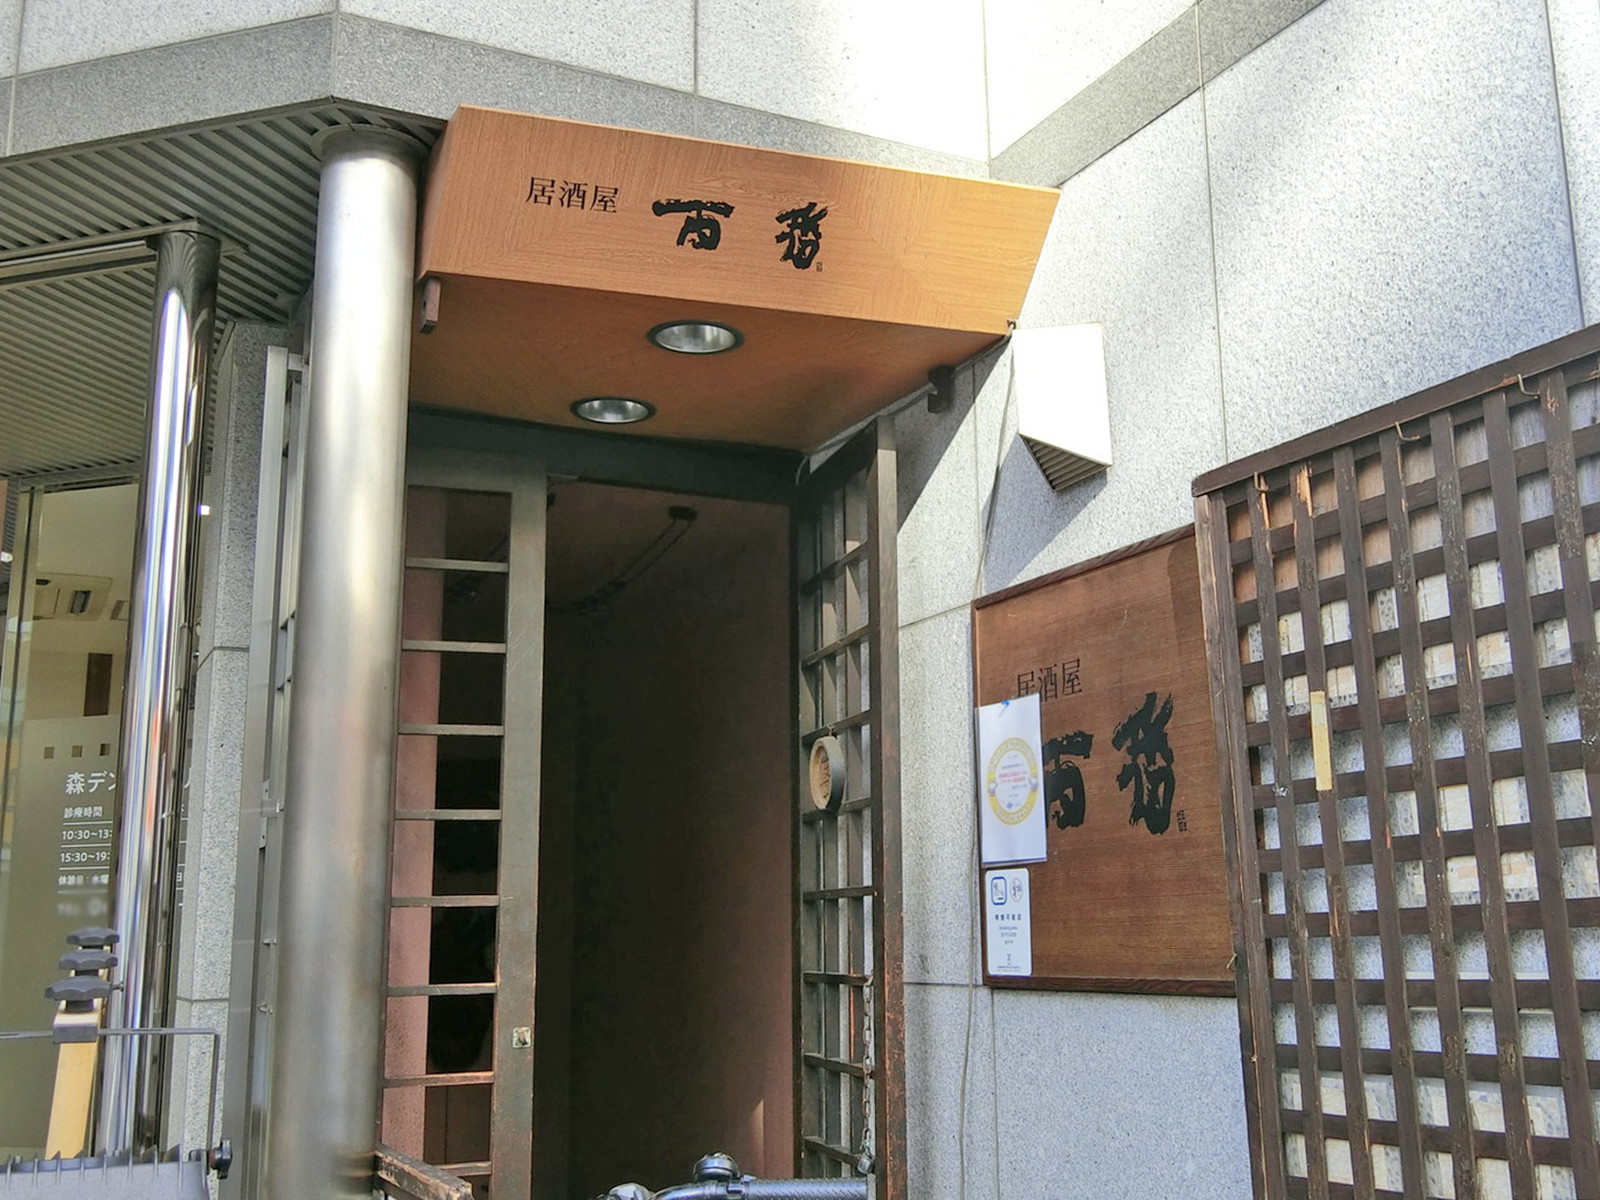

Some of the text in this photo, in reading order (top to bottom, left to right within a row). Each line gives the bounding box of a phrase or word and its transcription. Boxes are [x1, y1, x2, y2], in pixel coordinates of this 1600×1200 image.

[526, 177, 619, 213] 居酒屋
[1017, 658, 1082, 702] 居酒屋
